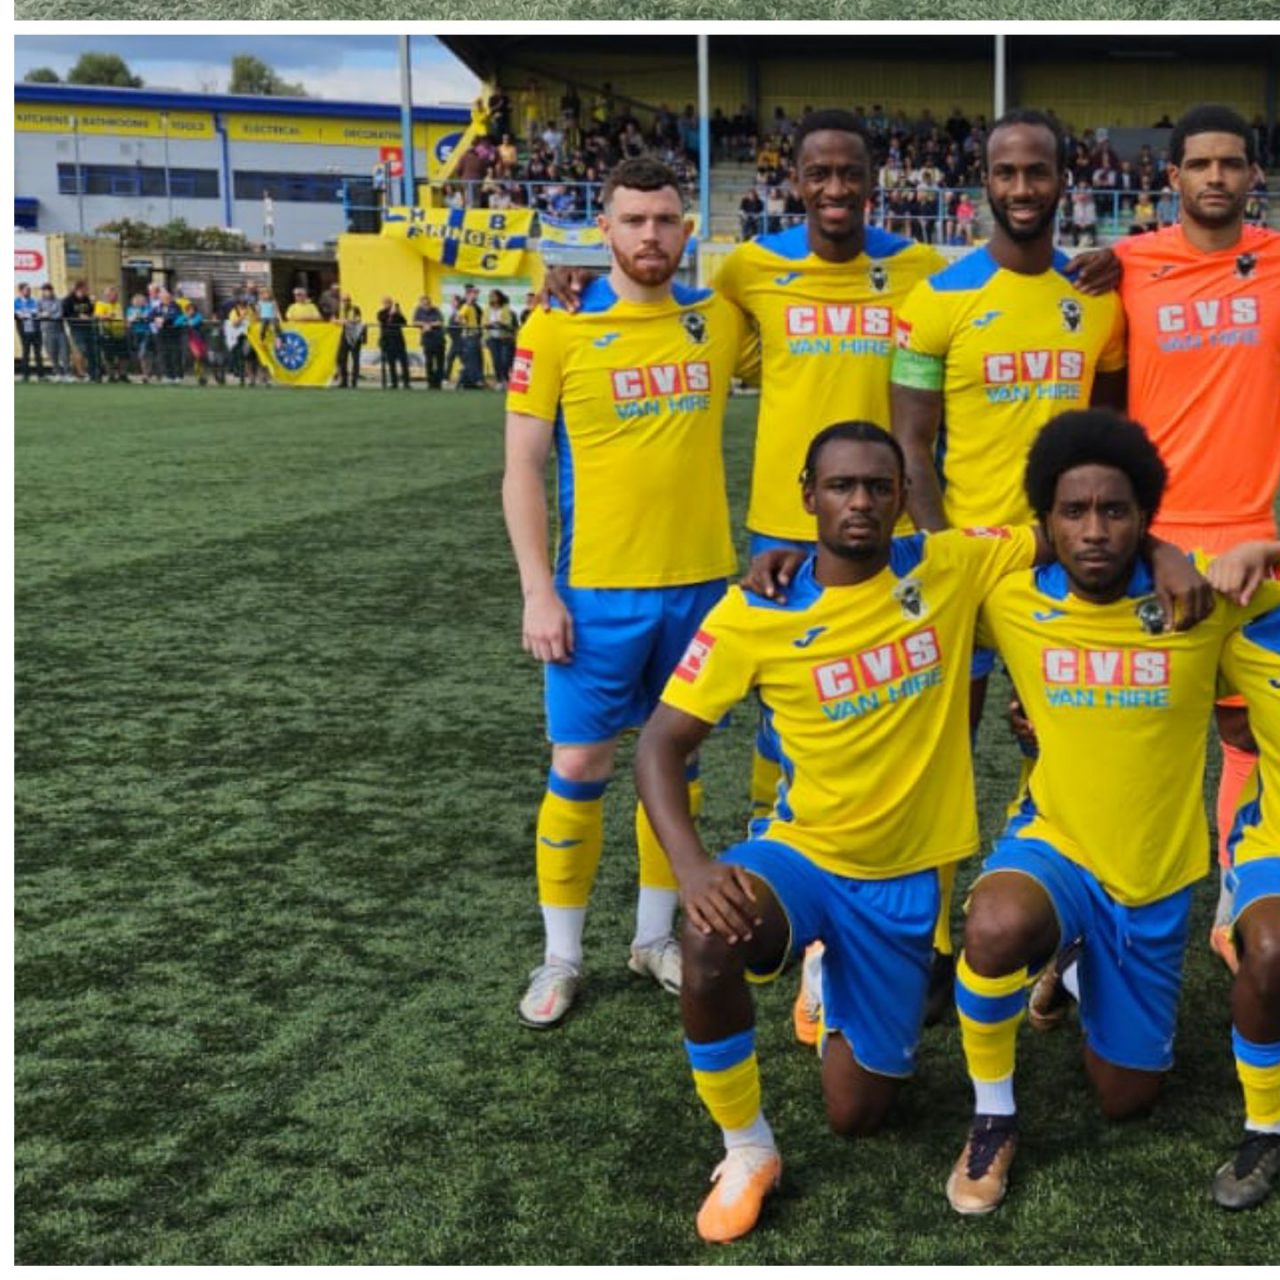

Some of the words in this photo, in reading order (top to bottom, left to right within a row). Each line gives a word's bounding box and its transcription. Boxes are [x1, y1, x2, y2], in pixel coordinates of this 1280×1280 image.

[786, 305, 893, 337] CVS
[1157, 297, 1259, 332] CVS
[787, 336, 832, 357] VAN
[839, 339, 890, 357] HIRE
[1157, 332, 1203, 353] VAN
[1208, 328, 1260, 348] HIRE
[611, 361, 711, 401] CVS
[984, 350, 1084, 385] CVS
[615, 399, 661, 420] VAN
[667, 393, 711, 413] HIRE
[986, 383, 1029, 403] VAN
[1036, 381, 1081, 401] HIRE
[813, 626, 941, 702] CVS
[1043, 648, 1170, 686] CVS
[821, 690, 882, 723] VAN
[887, 666, 945, 705] HIRE
[1045, 687, 1095, 707] VAN
[1103, 687, 1170, 708] HIRE
